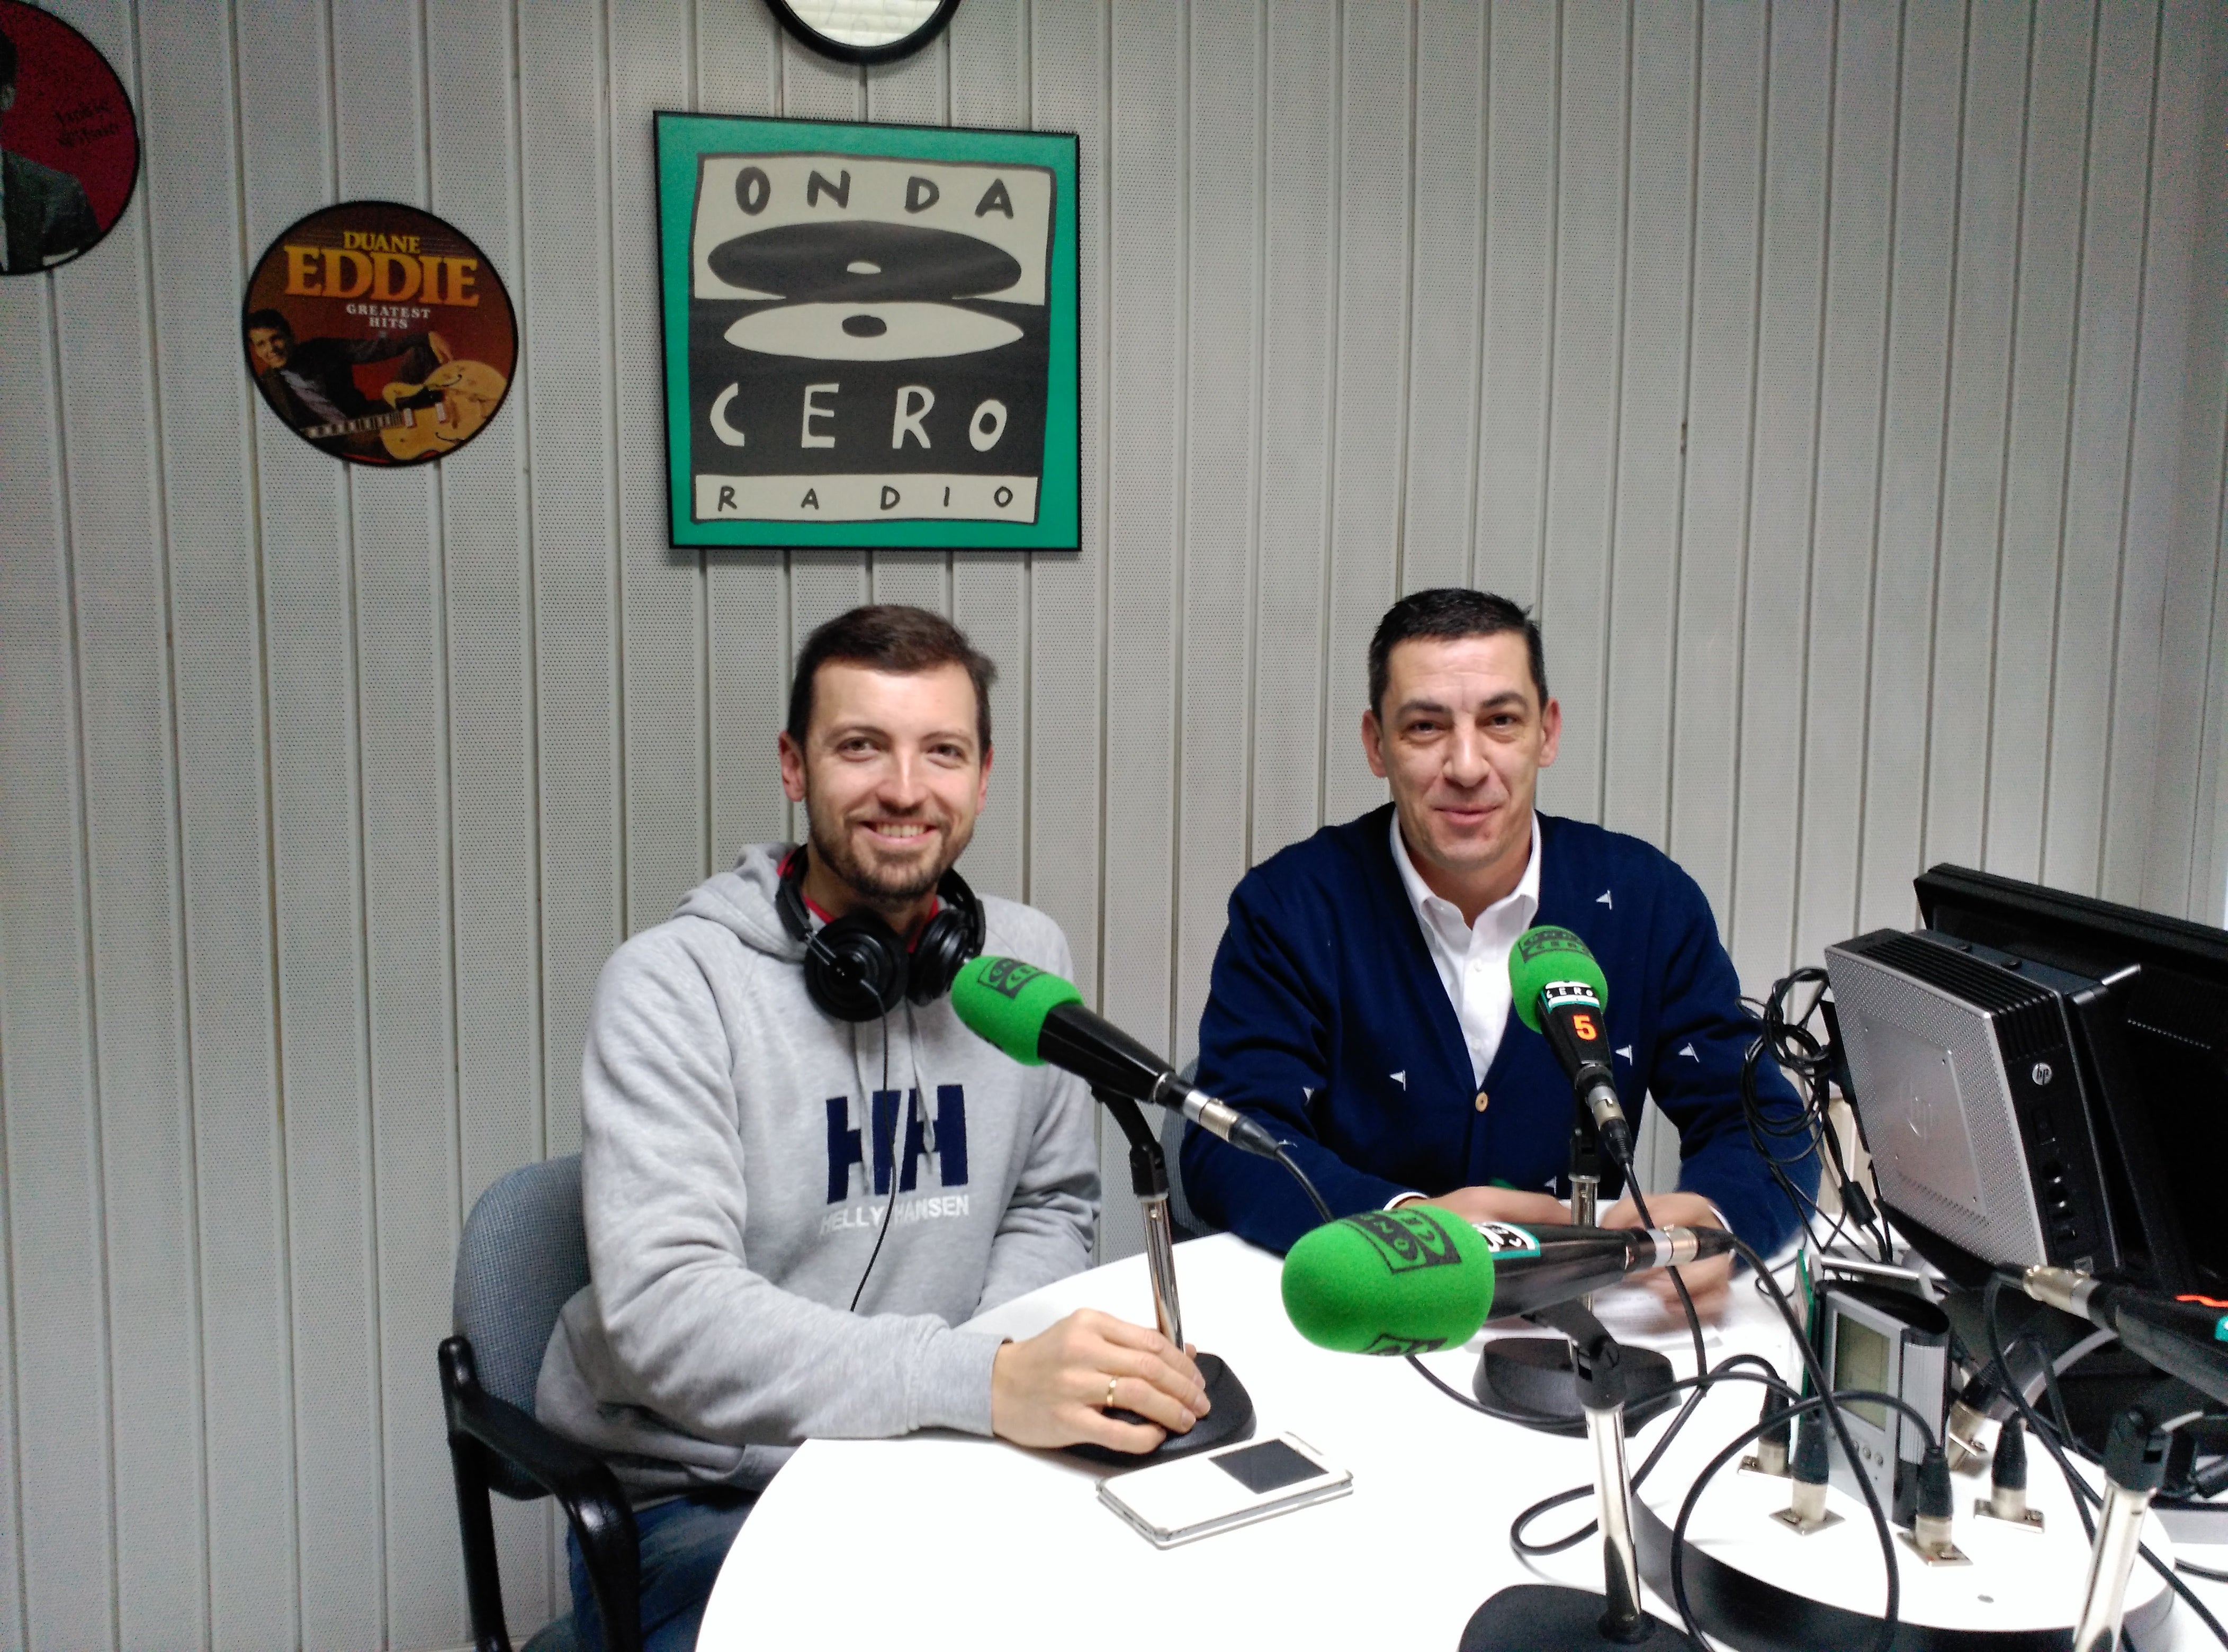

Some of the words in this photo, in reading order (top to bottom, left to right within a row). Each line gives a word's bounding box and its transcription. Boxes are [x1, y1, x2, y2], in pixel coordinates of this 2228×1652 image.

[735, 166, 1015, 219] ONDA
[343, 231, 421, 254] DUANE
[283, 245, 480, 308] EDDIE
[346, 303, 430, 319] GREATEST
[369, 316, 408, 329] HITS
[709, 382, 1008, 453] CERO
[717, 486, 1014, 511] RADIO
[1546, 986, 1594, 999] CERO
[1573, 1014, 1596, 1040] 5
[2036, 1064, 2049, 1084] hp
[821, 1206, 885, 1234] HELLY
[894, 1195, 969, 1226] HANSEN
